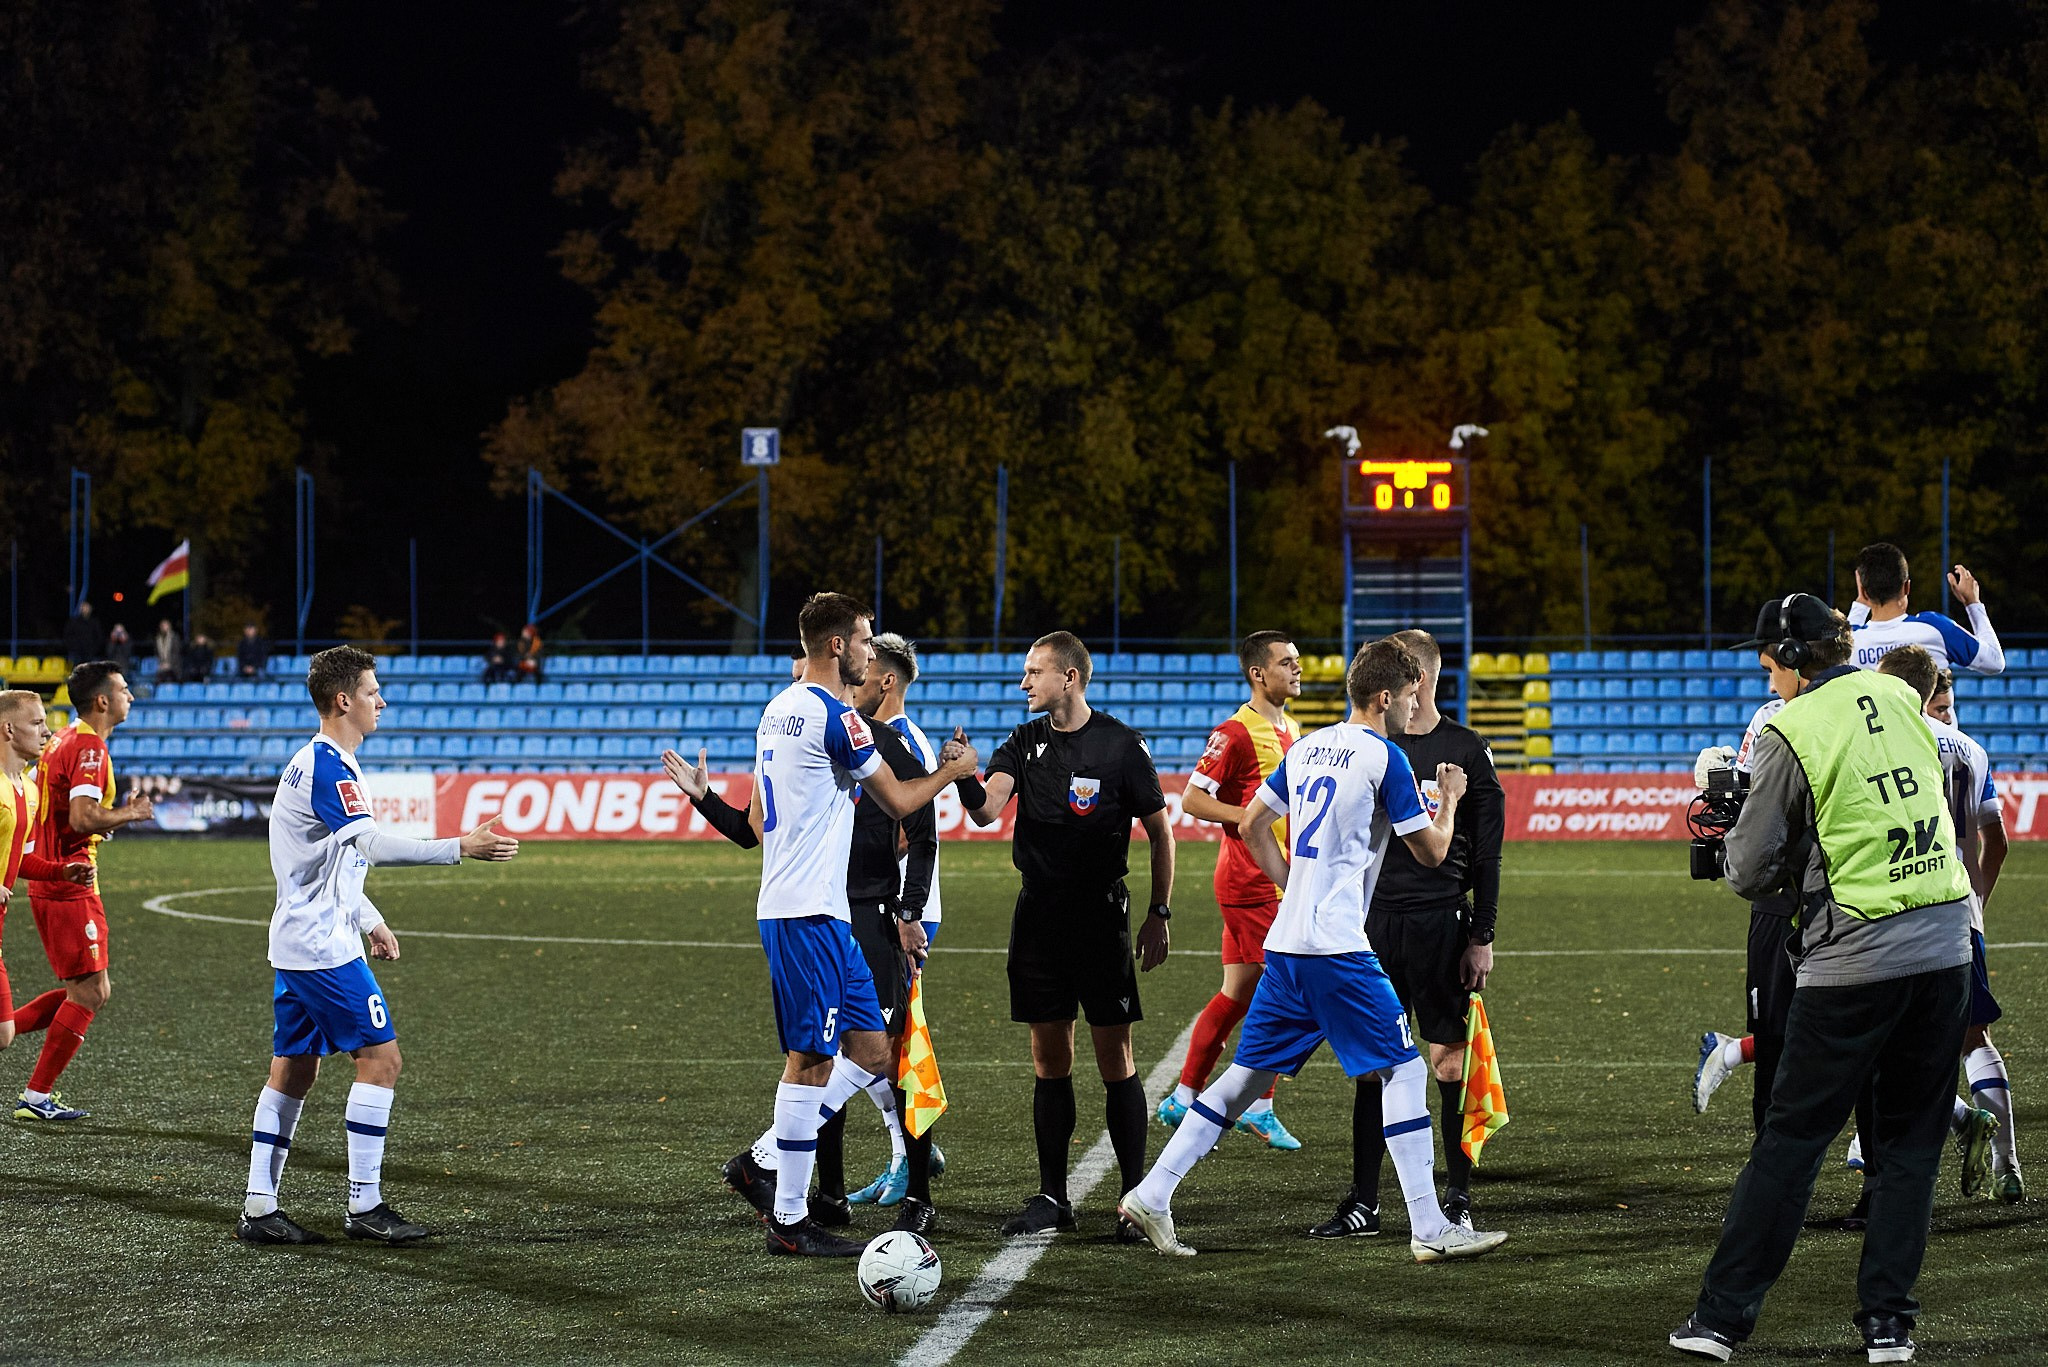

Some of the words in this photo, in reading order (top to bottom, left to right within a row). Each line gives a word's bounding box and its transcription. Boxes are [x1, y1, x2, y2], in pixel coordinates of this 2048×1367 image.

[752, 436, 769, 457] 8
[1375, 484, 1393, 510] 0
[1433, 483, 1450, 510] 0
[1856, 695, 1884, 735] 2
[1301, 746, 1356, 770] БРОВЧУК
[1534, 788, 1610, 807] КУБОК
[1295, 776, 1337, 859] 12
[1528, 813, 1562, 832] ПО
[1565, 813, 1671, 832] ФУТБОЛУ
[1887, 816, 1944, 865] 2K
[1889, 855, 1946, 883] SPORT
[368, 994, 387, 1029] 6
[1751, 987, 1758, 1019] 1
[823, 1007, 838, 1043] 5
